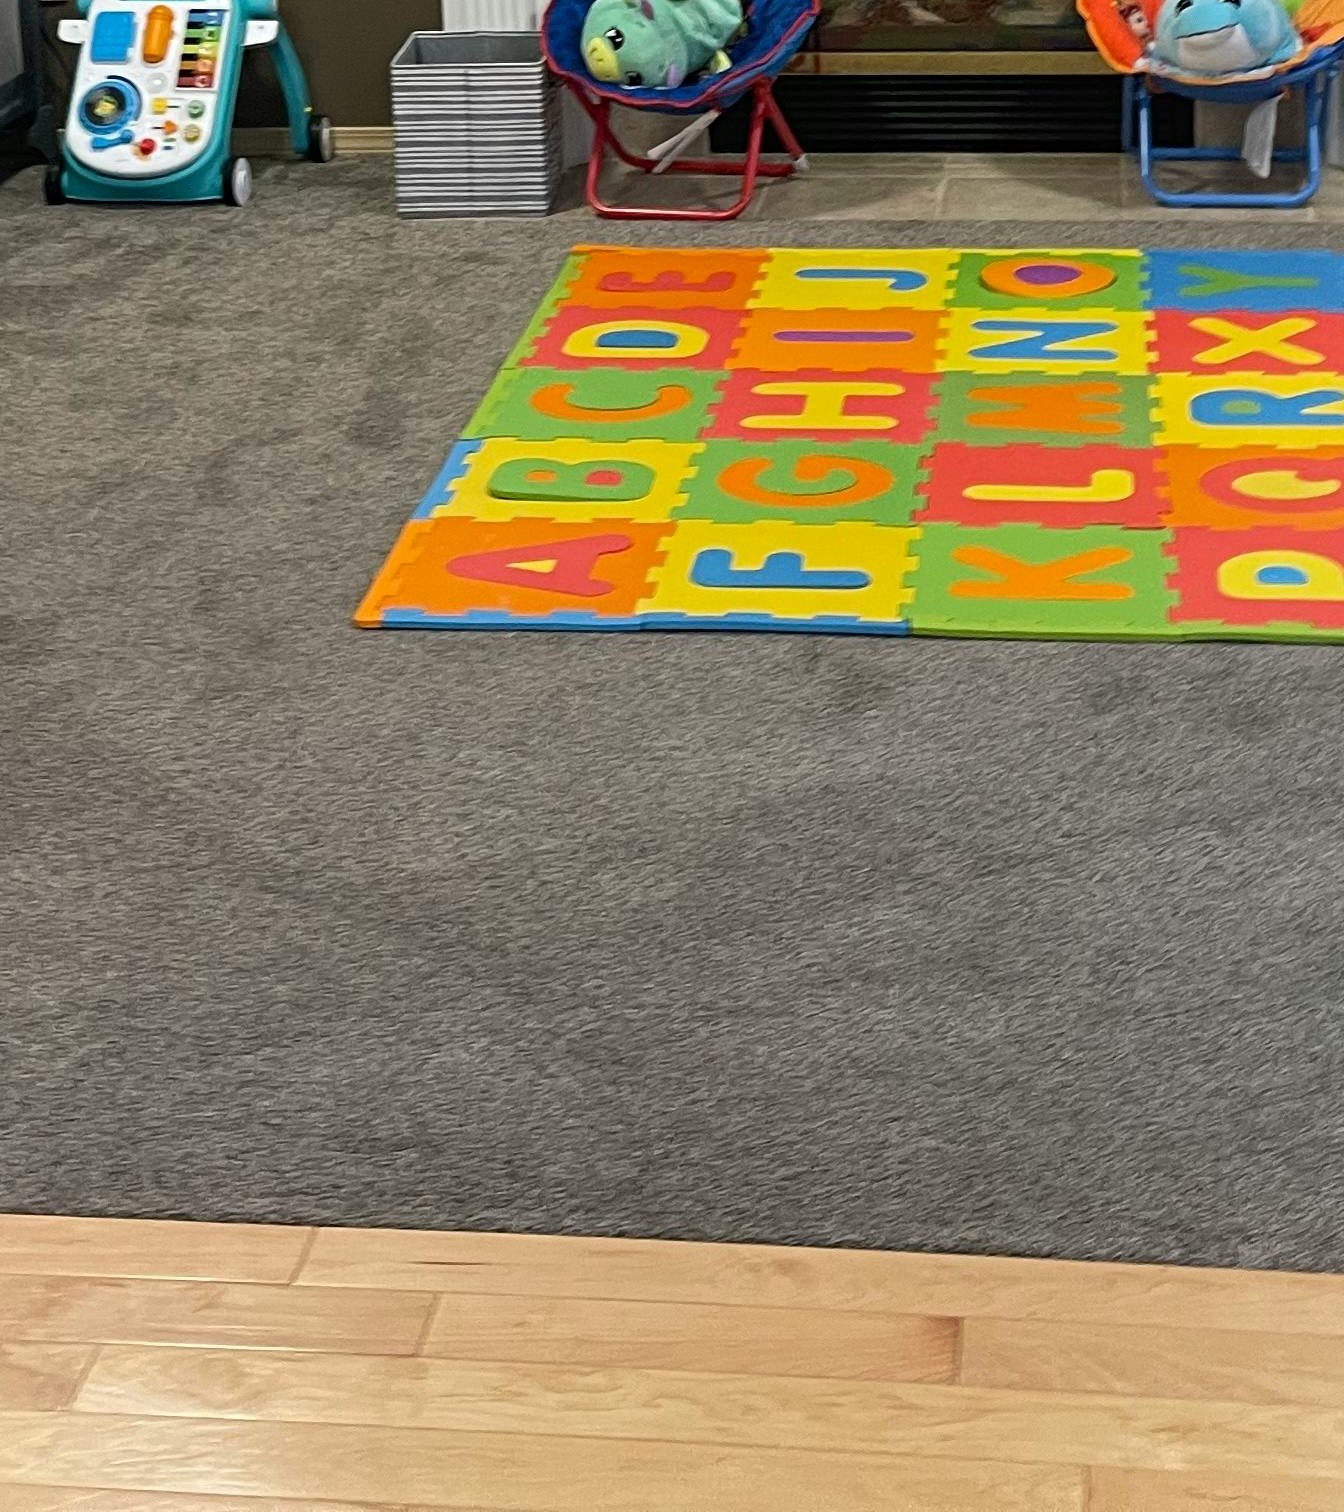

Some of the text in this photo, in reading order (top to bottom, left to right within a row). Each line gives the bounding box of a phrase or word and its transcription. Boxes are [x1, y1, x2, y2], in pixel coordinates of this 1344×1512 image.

[600, 271, 735, 293] E
[795, 267, 927, 292] J
[980, 257, 1117, 298] O
[1179, 264, 1321, 298] Y
[562, 319, 711, 359] D
[773, 330, 915, 343] I
[968, 319, 1118, 361] N
[1189, 316, 1325, 366] X
[530, 384, 694, 423] C
[738, 381, 906, 431] H
[965, 382, 1124, 434] M
[487, 458, 655, 502] B
[717, 454, 894, 510] G
[961, 468, 1136, 503] L
[446, 533, 633, 598] A
[689, 548, 872, 589] F
[947, 546, 1134, 601] K
